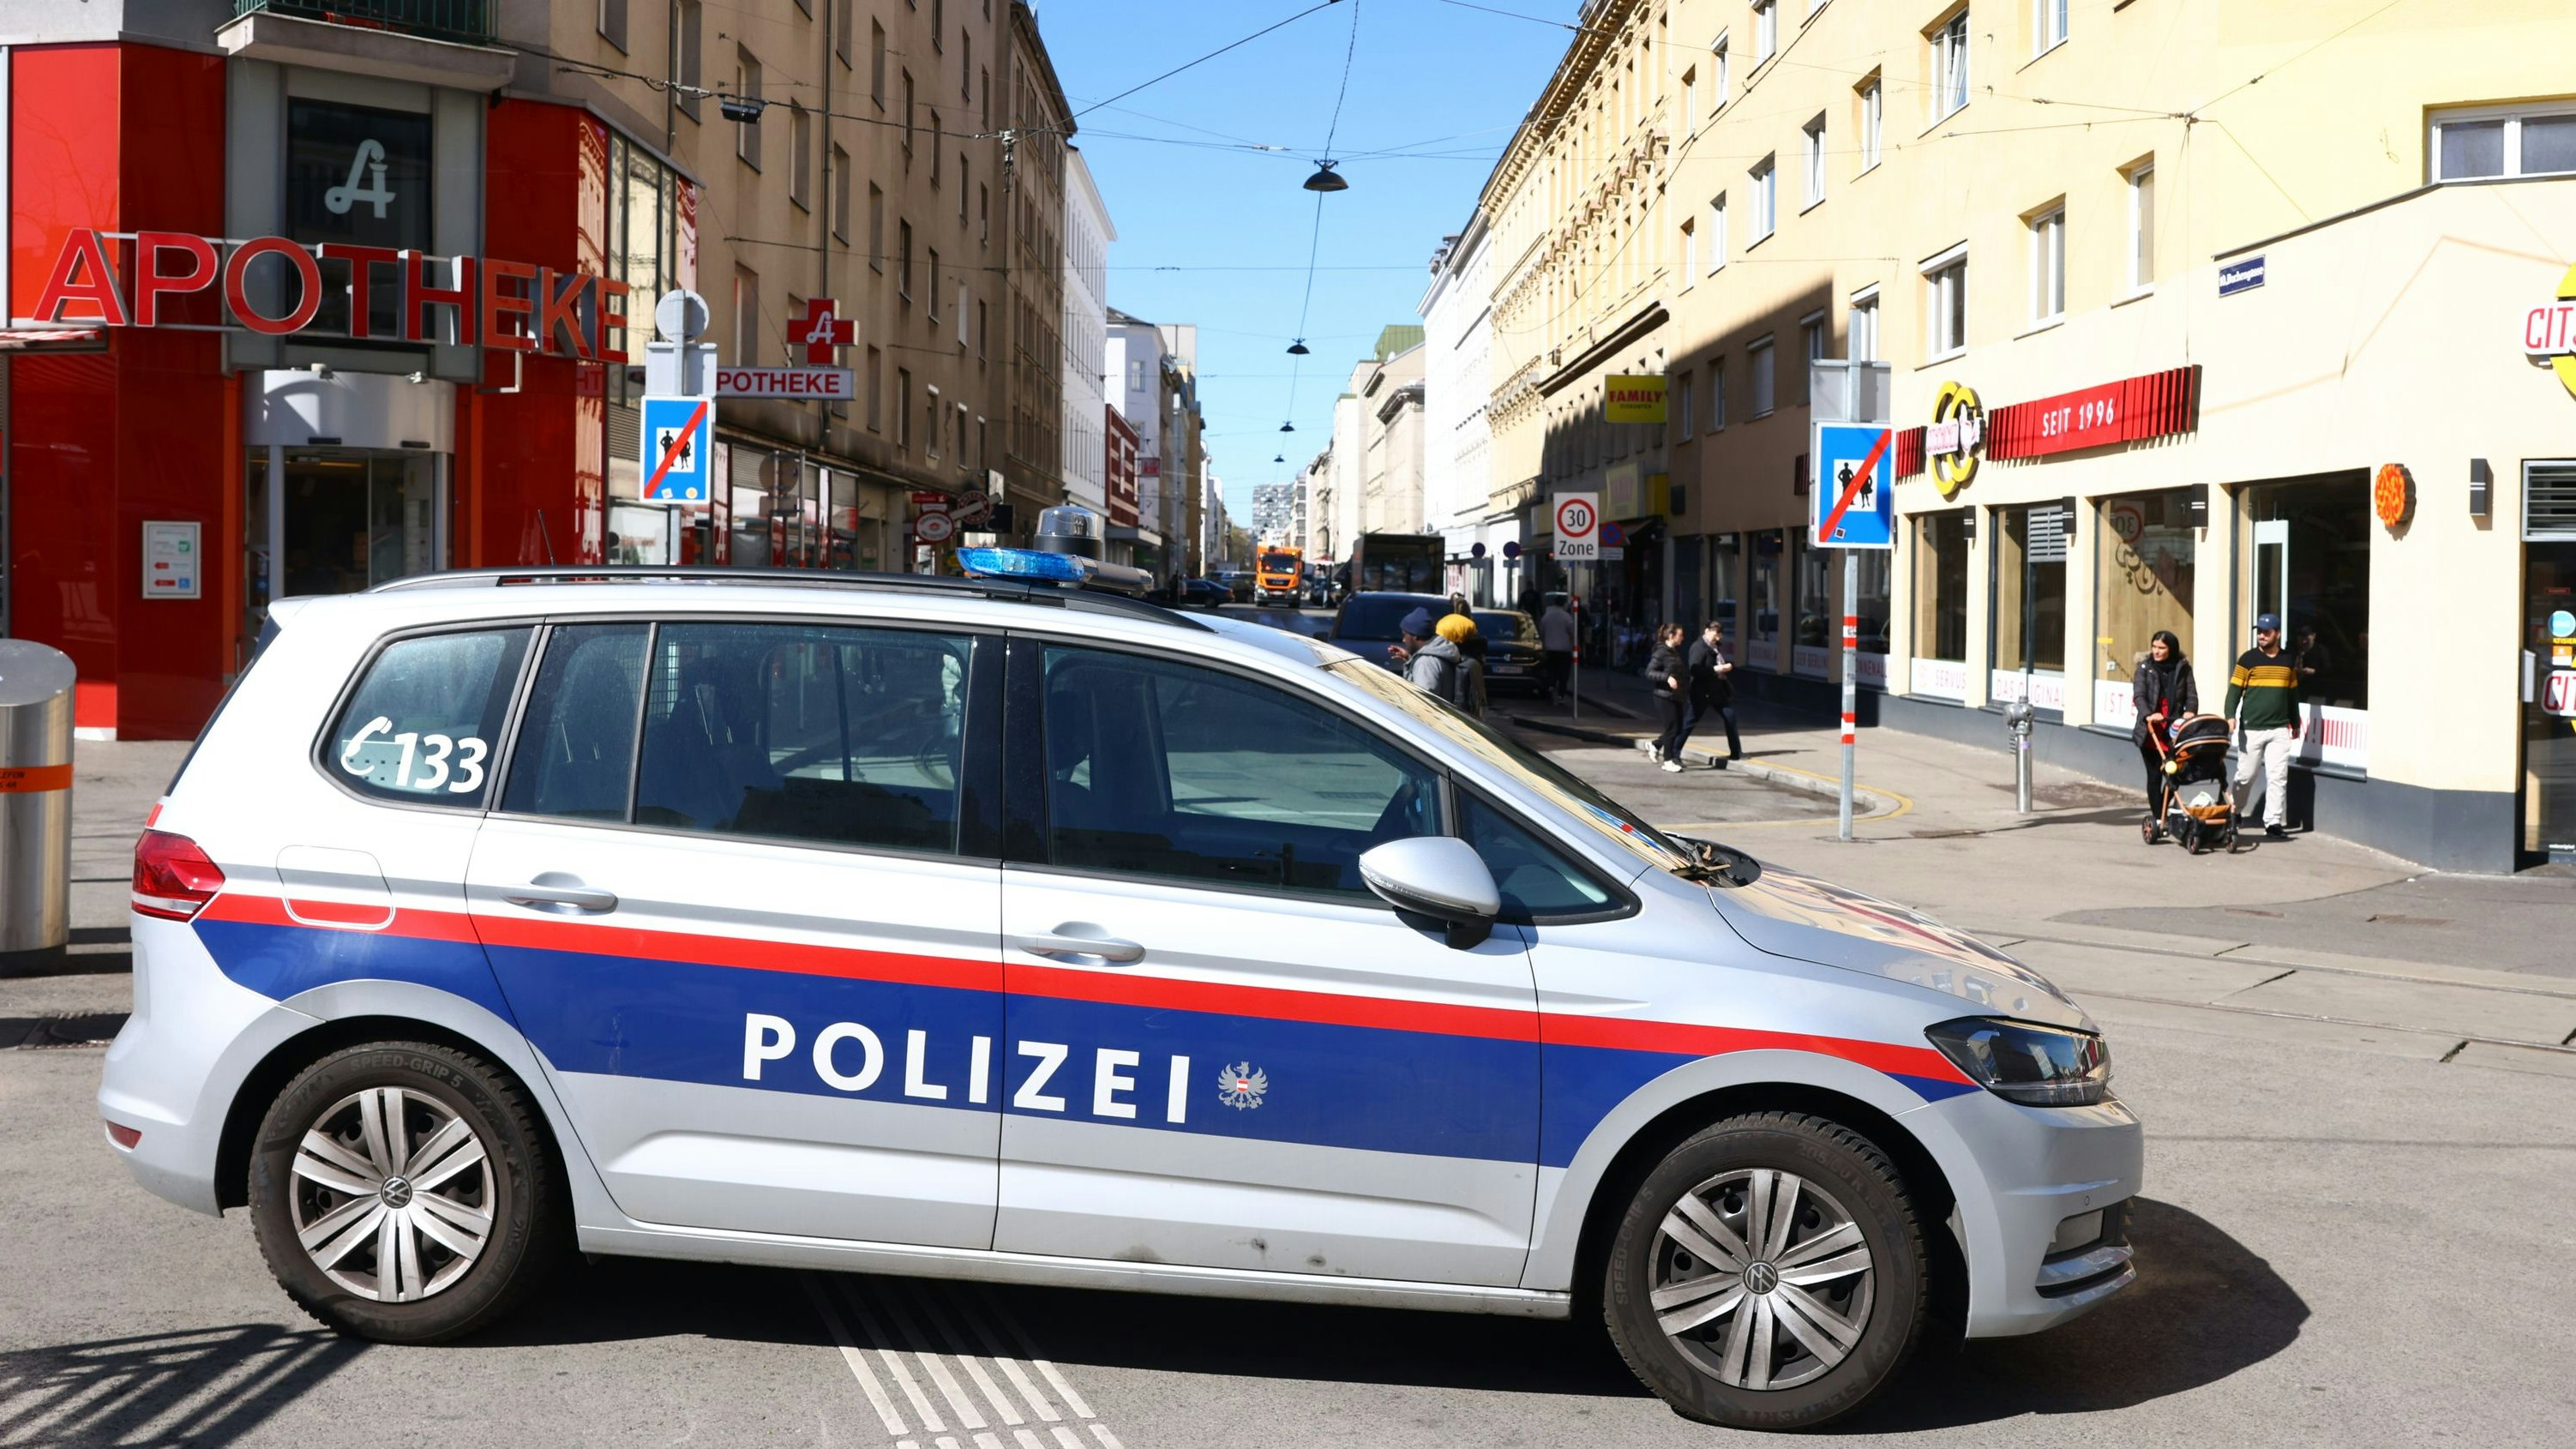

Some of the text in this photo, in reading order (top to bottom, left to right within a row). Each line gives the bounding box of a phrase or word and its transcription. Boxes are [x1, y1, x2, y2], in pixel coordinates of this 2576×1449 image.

[32, 227, 628, 364] APOTHEKE
[2525, 307, 2576, 349] CIT
[717, 371, 840, 394] POTHEKE
[1608, 390, 1663, 403] FAMILY
[2042, 398, 2115, 437] SEIT 1996
[1567, 509, 1586, 527] 30
[1558, 540, 1594, 556] Zone
[1936, 669, 1967, 689] SERVUS
[1996, 678, 2065, 707] DAS OIGINAL
[2104, 691, 2126, 714] IST
[394, 732, 488, 793] 133
[350, 1055, 464, 1088] SPEED-GRIP 5
[742, 1013, 1190, 1124] POLIZEI
[1614, 1187, 1654, 1306] SPEED-GRIP 5
